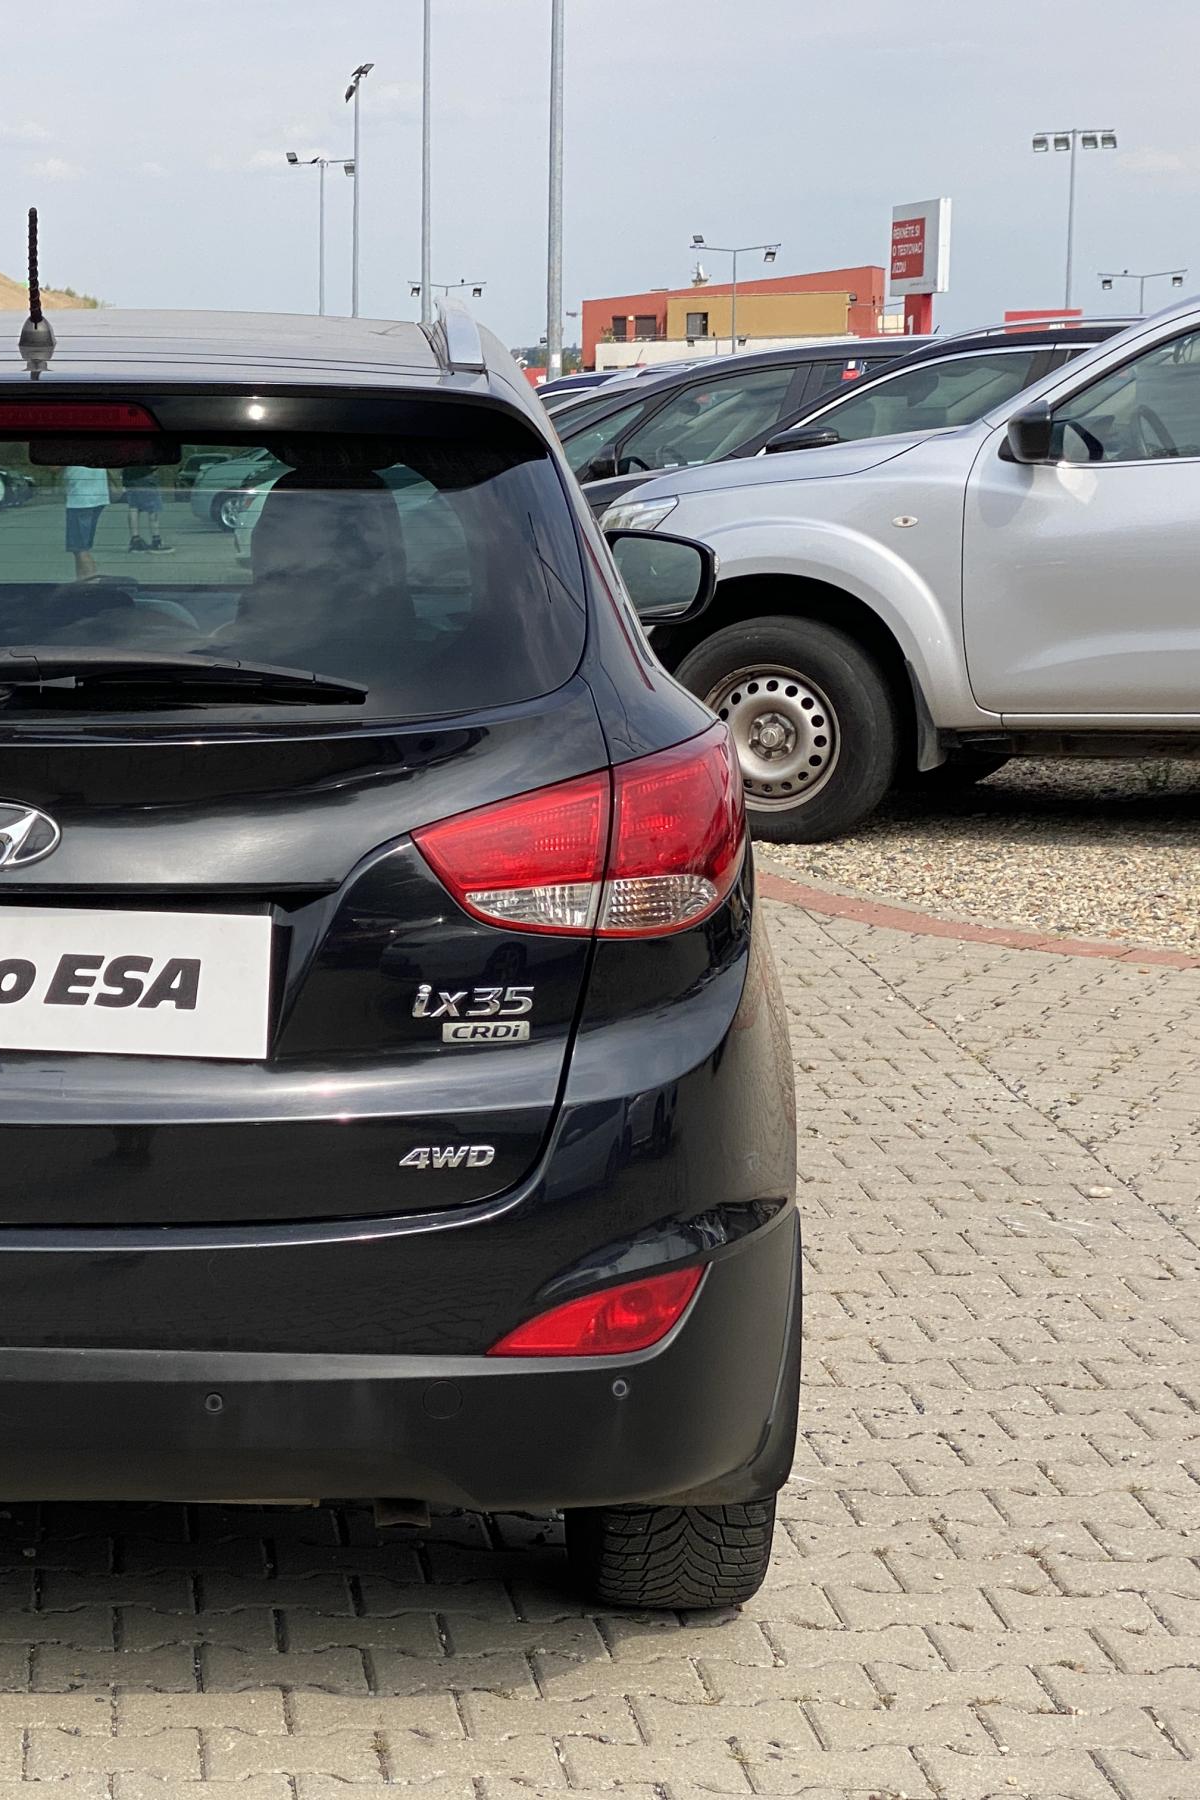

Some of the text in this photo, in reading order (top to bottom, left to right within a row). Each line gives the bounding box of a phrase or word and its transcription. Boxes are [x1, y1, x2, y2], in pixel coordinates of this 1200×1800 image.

[43, 953, 201, 1010] ESA
[411, 984, 535, 1018] ix35
[451, 1024, 521, 1039] CRDi
[398, 1145, 495, 1169] 4WD
